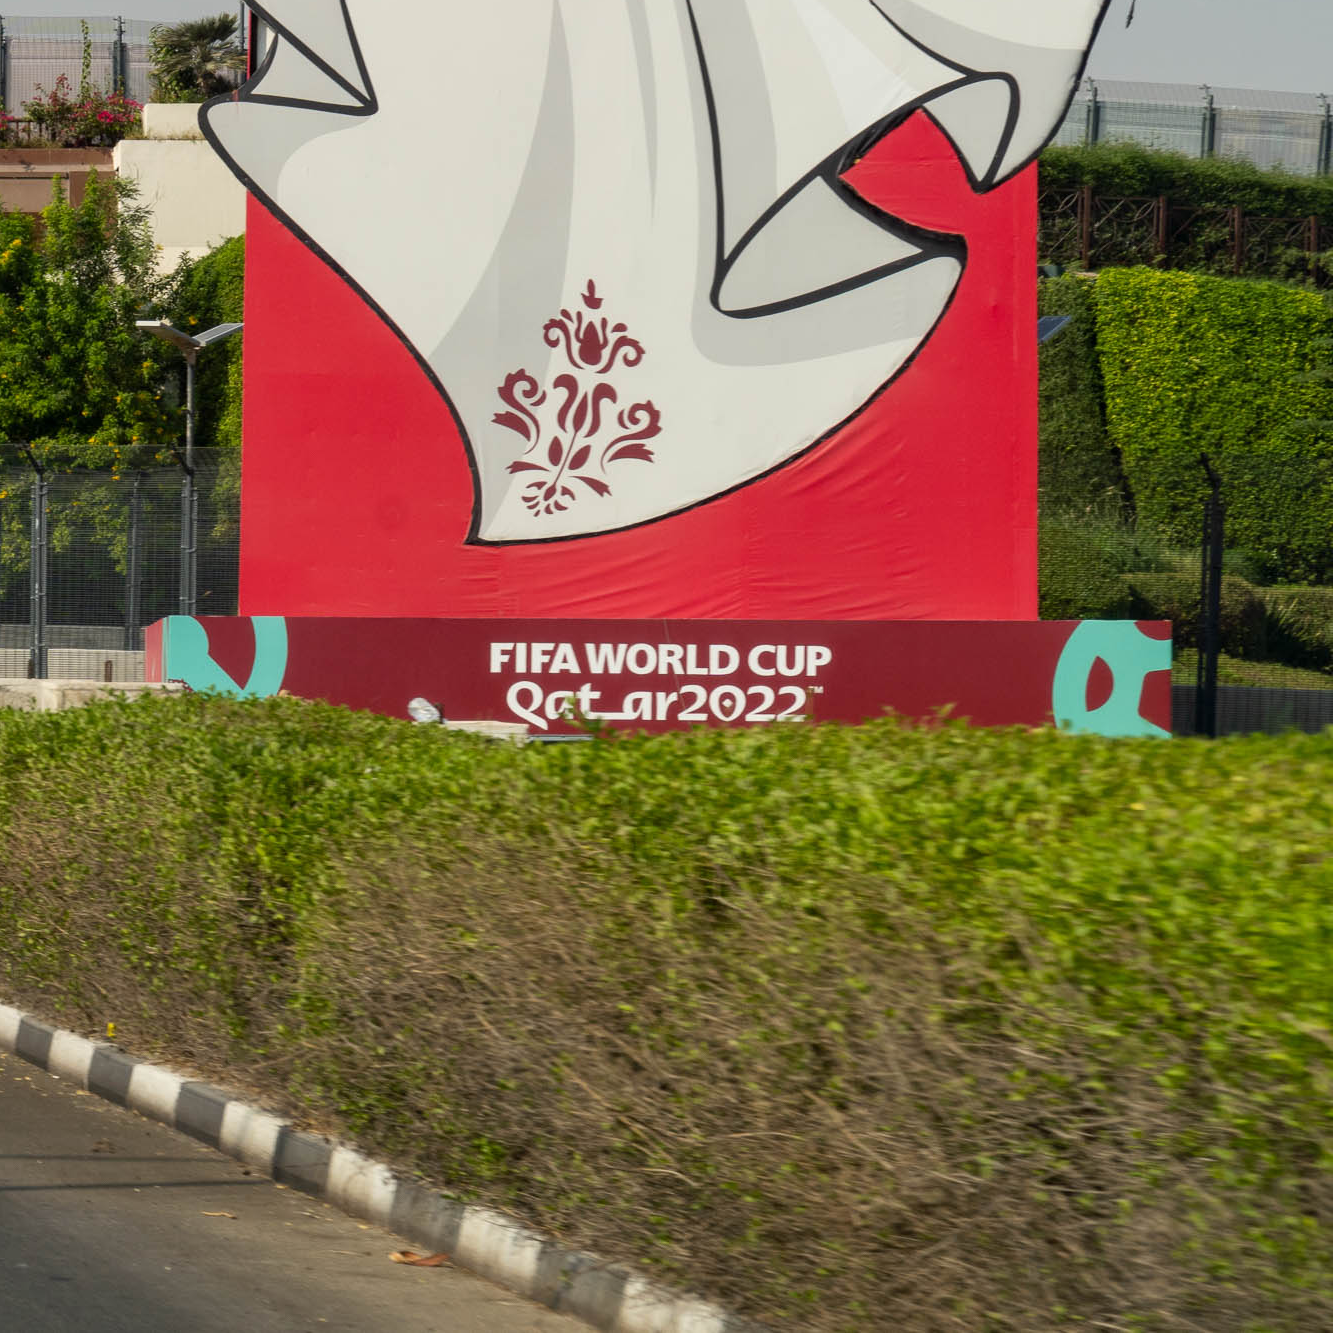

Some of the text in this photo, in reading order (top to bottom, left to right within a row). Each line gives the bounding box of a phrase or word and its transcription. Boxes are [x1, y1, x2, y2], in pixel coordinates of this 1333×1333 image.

[490, 642, 832, 676] FIFA WORLD CUP
